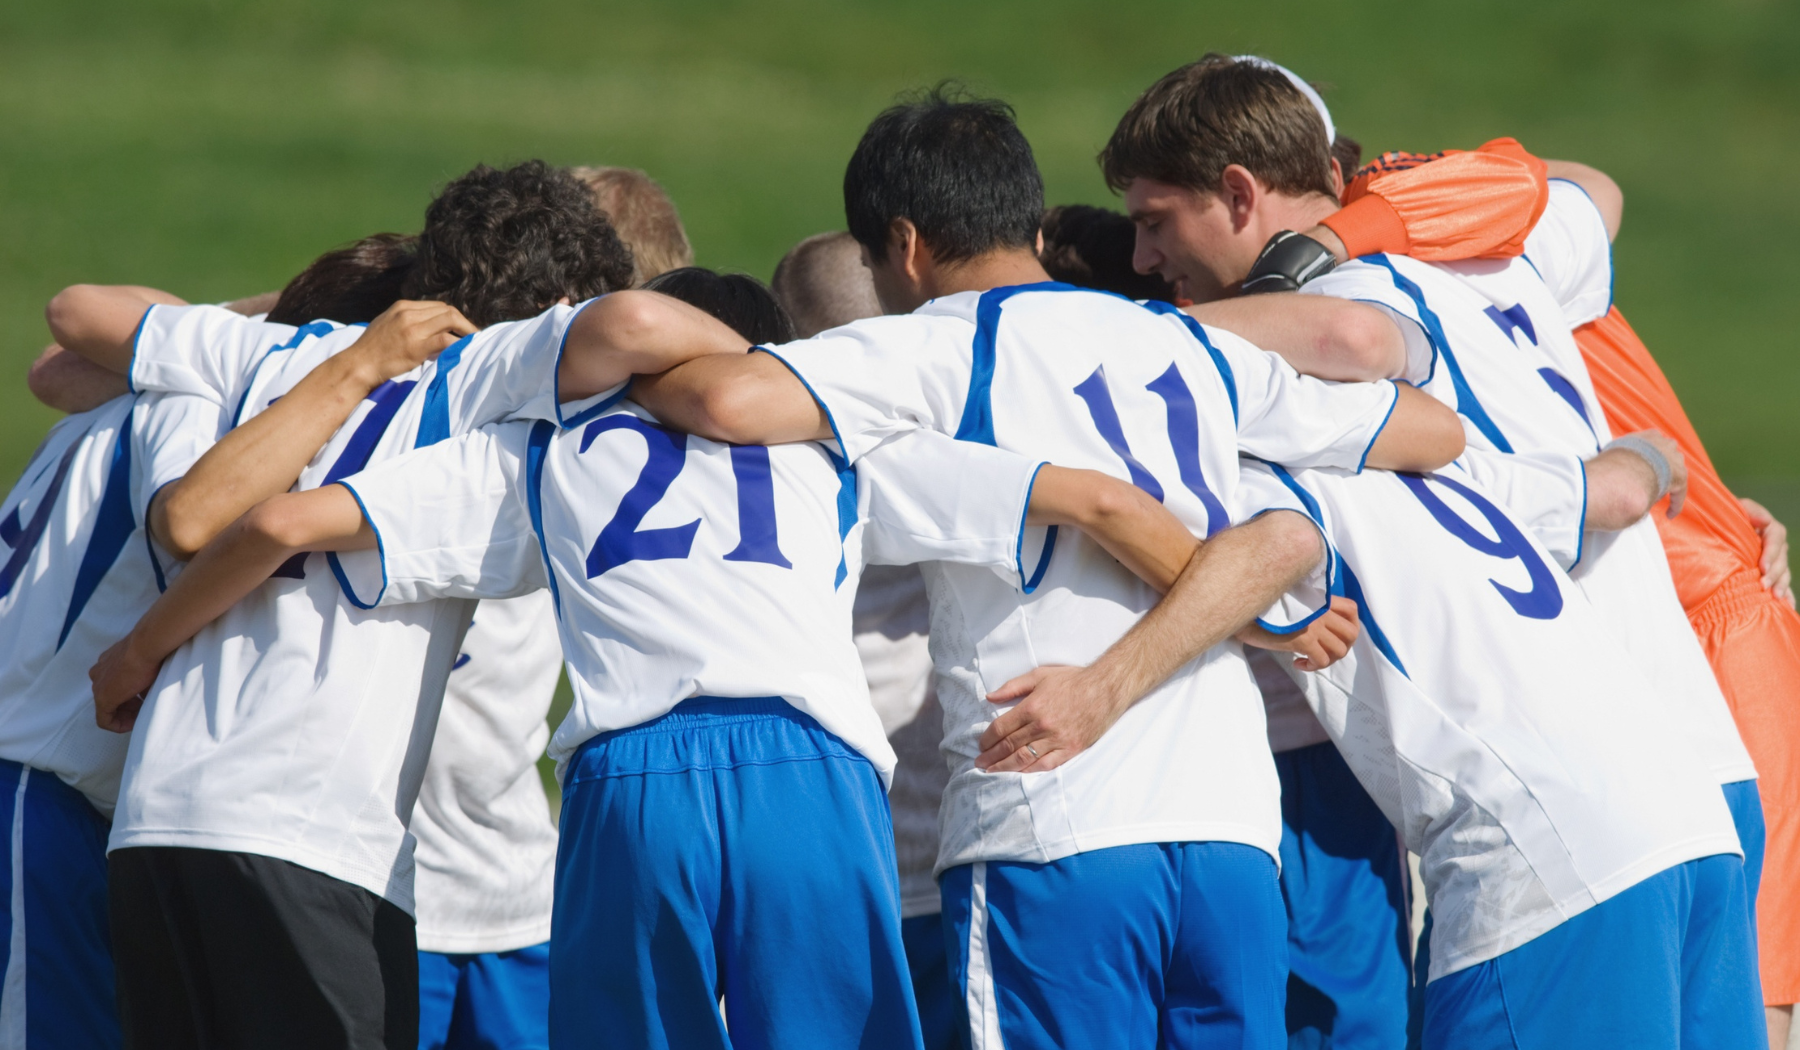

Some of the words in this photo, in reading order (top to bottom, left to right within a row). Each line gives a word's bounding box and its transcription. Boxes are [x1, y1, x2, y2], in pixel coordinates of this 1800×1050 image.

[579, 413, 793, 580] 21
[1072, 360, 1231, 539] 11
[1395, 471, 1564, 621] 9
